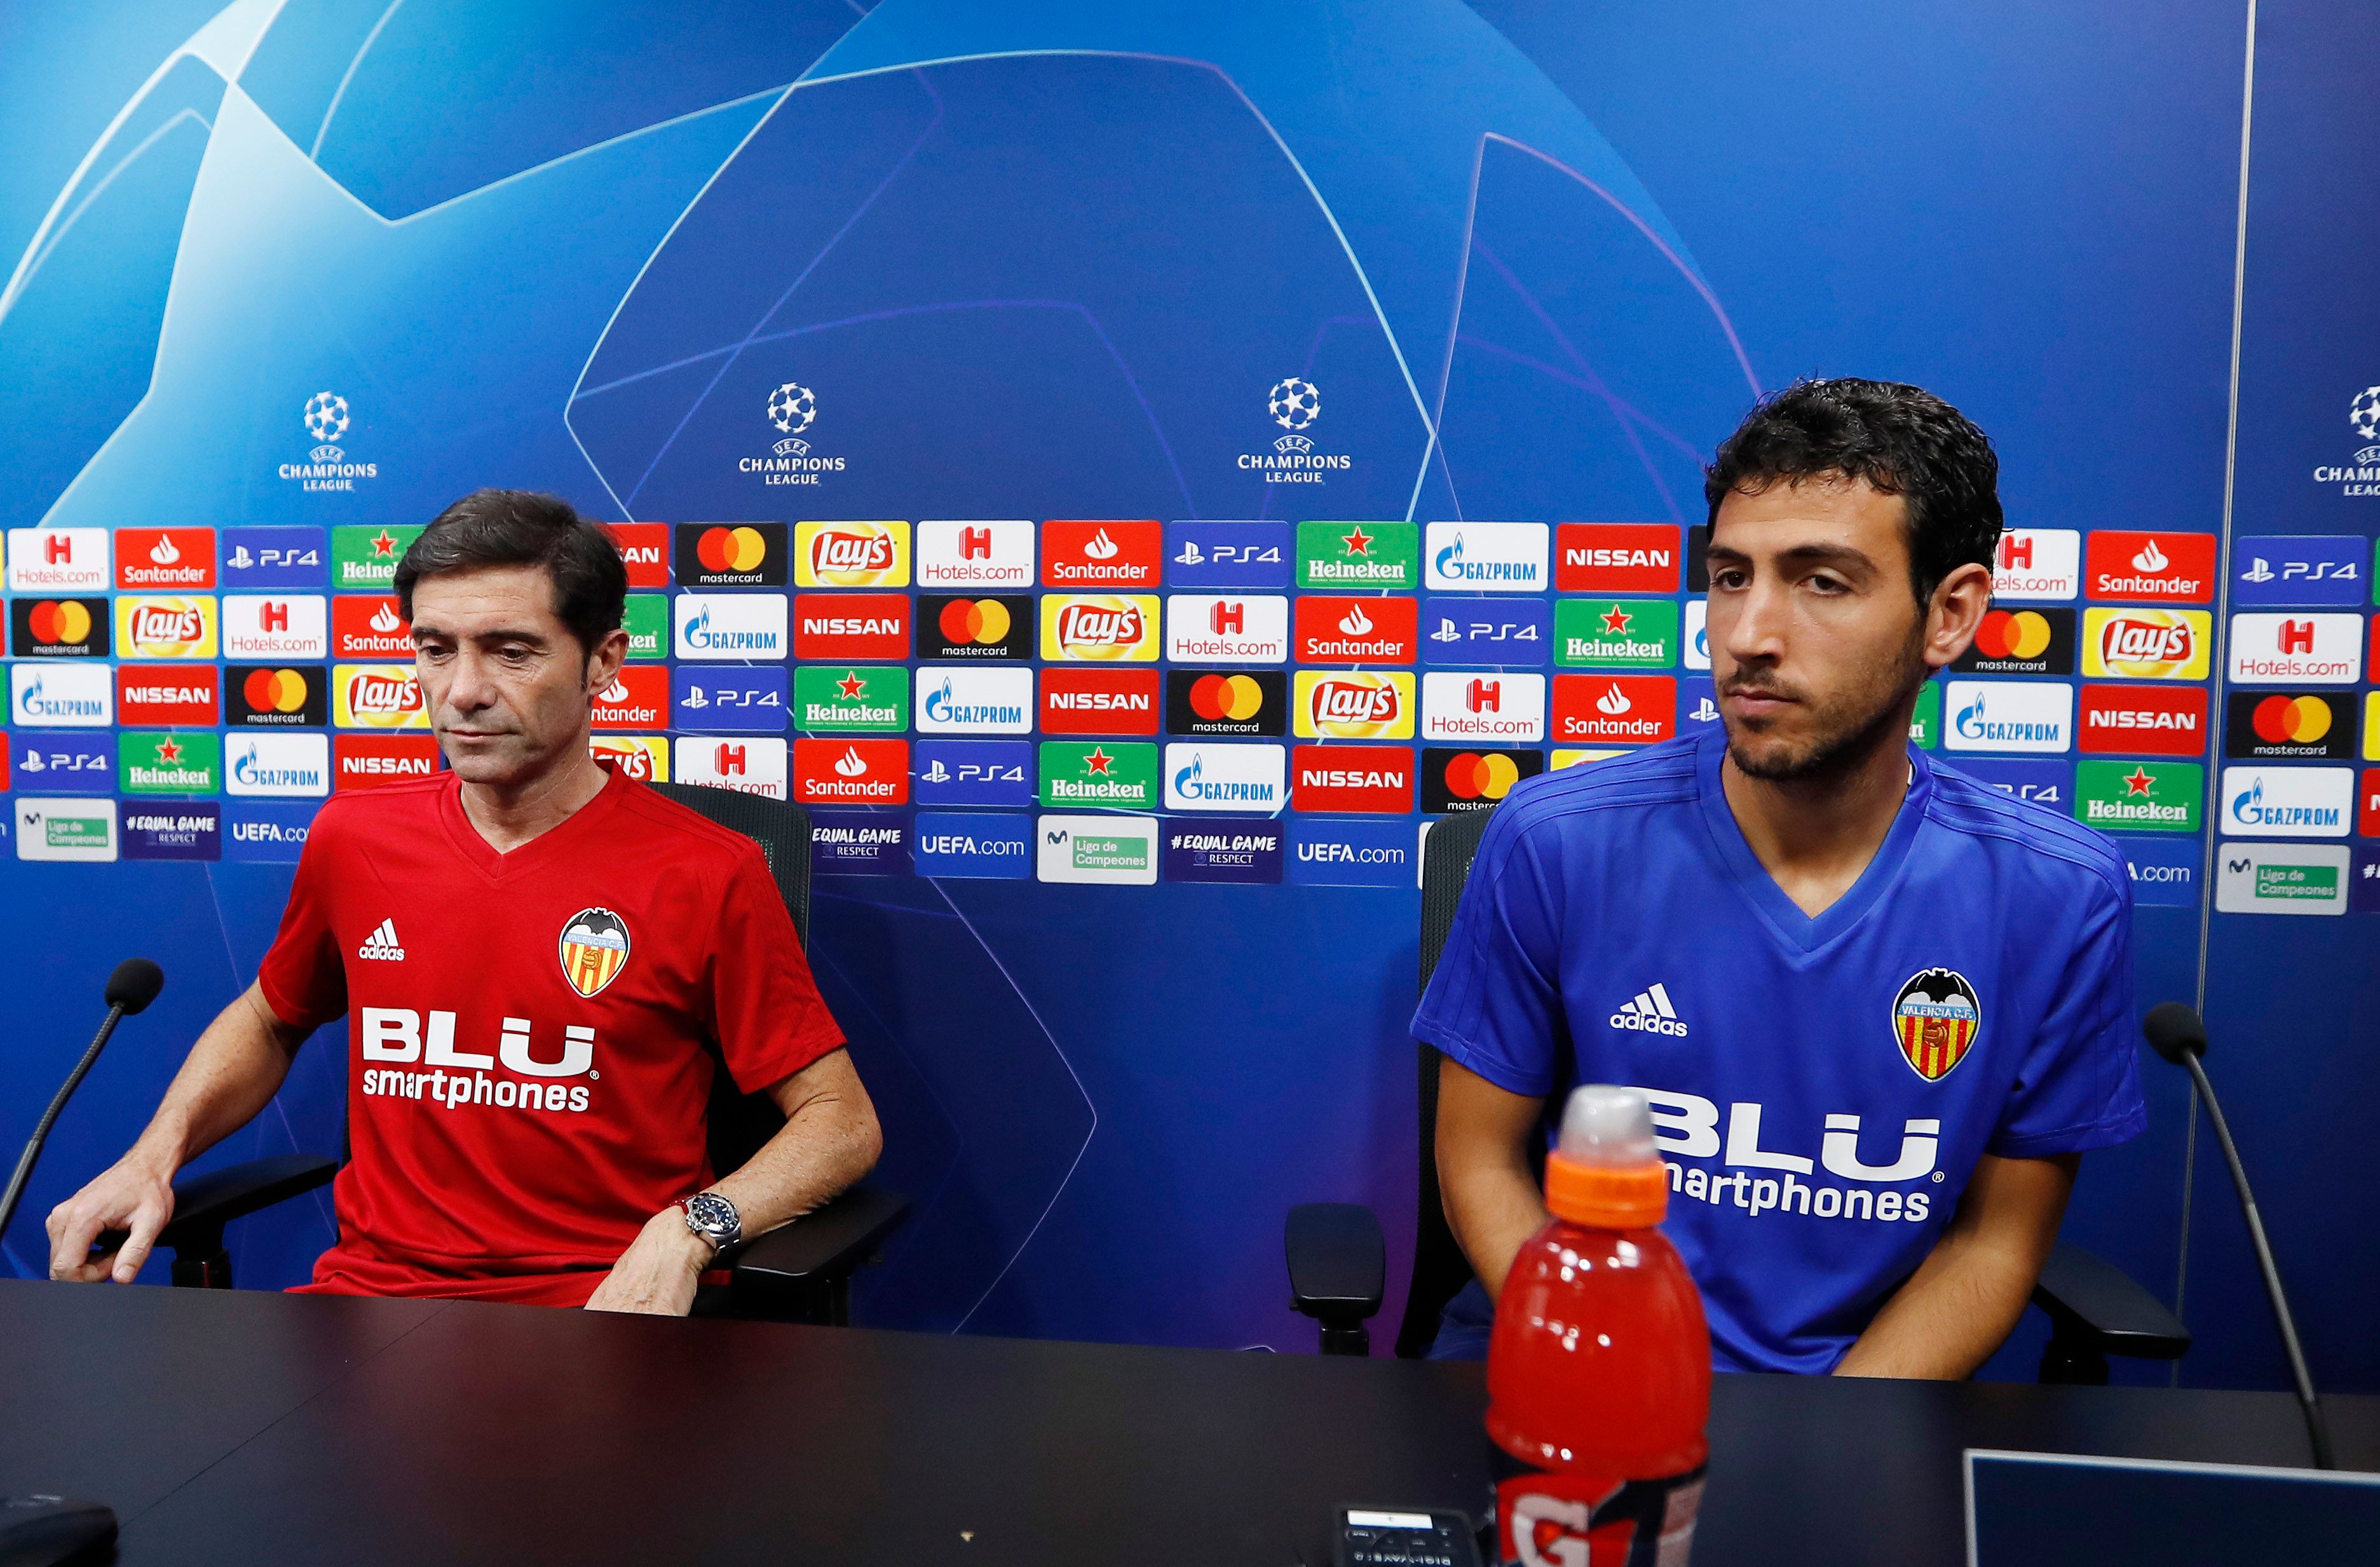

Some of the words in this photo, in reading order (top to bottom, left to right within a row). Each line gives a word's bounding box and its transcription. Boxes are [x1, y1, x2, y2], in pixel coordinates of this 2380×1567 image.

[774, 441, 808, 455] UEFA
[1275, 438, 1311, 452] UEFA
[310, 447, 343, 462] UEFA
[1237, 454, 1352, 470] CHAMPIONS
[2355, 449, 2380, 463] UE
[278, 463, 377, 479] CHAMPIONS
[738, 457, 847, 472] CHAMPIONS
[303, 479, 353, 492] LEAGUE
[765, 474, 819, 485] LEAGUE
[1266, 472, 1323, 483] LEAGUE
[44, 534, 71, 564] H
[959, 526, 991, 560] H
[260, 549, 319, 567] PS4
[817, 534, 886, 572] Lay's
[1213, 546, 1281, 563] PS4
[1567, 549, 1669, 567] NISSAN
[17, 568, 100, 583] Hotels.com
[125, 566, 206, 583] Santander
[343, 561, 398, 579] Heine
[700, 573, 763, 583] mastercard
[927, 564, 1024, 580] Hotels.com
[1054, 562, 1148, 579] Santander
[1309, 560, 1406, 579] Heineken
[1466, 562, 1536, 581] GAZPROM
[2283, 562, 2358, 580] PS4
[2098, 574, 2200, 594] Santander
[136, 604, 198, 638] Lay's
[260, 602, 288, 632] H
[1210, 601, 1243, 635] H
[804, 618, 899, 635] NISSAN
[1064, 606, 1137, 646] Lay's
[1470, 623, 1539, 641] PS4
[231, 636, 317, 652] Hotels.com
[343, 634, 416, 651] Santand
[712, 632, 777, 649] GAZPROM
[2107, 620, 2186, 661] Lay's
[2278, 620, 2314, 655] H
[33, 644, 90, 655] mastercard
[942, 645, 1007, 656] mastercard
[1177, 639, 1277, 655] Hotels.com
[1307, 637, 1404, 656] Santander
[1567, 638, 1664, 657] Heineken
[1976, 660, 2046, 672] mastercard
[2240, 659, 2348, 675] Hotels.com
[125, 686, 210, 703] NISSAN
[353, 676, 418, 712] Lay's
[716, 690, 780, 707] PS4
[1050, 693, 1149, 710] NISSAN
[1466, 678, 1500, 713] H
[45, 700, 102, 716] GAZPROM
[806, 703, 897, 721] Heineken
[1317, 685, 1392, 723] Lay's
[247, 713, 304, 724] mastercard
[590, 705, 656, 722] ntander
[954, 707, 1021, 723] GAZPROM
[2090, 710, 2196, 730] NISSAN
[1193, 722, 1259, 733] mastercard
[1432, 717, 1533, 734] Hotels.com
[1565, 717, 1662, 735] Santander
[1987, 722, 2059, 741] GAZPROM
[2255, 745, 2327, 756] mastercard
[51, 754, 107, 770] PS4
[343, 757, 430, 773] NISSAN
[715, 743, 745, 776] H
[129, 768, 209, 785] Heineken
[260, 770, 318, 786] GAZPROM
[959, 765, 1024, 782] PS4
[1302, 770, 1403, 789] NISSAN
[805, 780, 895, 796] Santander
[1052, 780, 1145, 797] Heineken
[1205, 782, 1273, 801] GAZPROM
[2088, 799, 2187, 820] Heineken
[2264, 808, 2339, 825] GAZPROM
[48, 820, 69, 834] Liga
[70, 822, 83, 832] de
[126, 816, 177, 832] #EQUAL
[177, 817, 215, 832] GAME
[233, 823, 309, 842] UEFA.co
[48, 832, 107, 846] Campeones
[158, 833, 196, 843] RESPECT
[858, 828, 901, 844] GAME
[1171, 834, 1230, 851] #EQUAL
[1232, 835, 1277, 851] GAME
[837, 846, 879, 856] RESPECT
[921, 836, 1024, 855] UEFA.com
[1077, 841, 1099, 855] Liga
[1102, 841, 1117, 852] de
[1298, 843, 1405, 864] UEFA.com
[1077, 855, 1145, 868] Campeones
[1209, 854, 1254, 864] RESPECT
[2261, 869, 2285, 883] Liga
[2290, 870, 2305, 881] de
[2259, 883, 2335, 897] Campeones
[568, 934, 607, 947] VALENCIA
[358, 944, 405, 961] adidas
[1901, 1005, 1952, 1017] VALENCIA
[1610, 1012, 1688, 1038] adidas
[362, 1007, 595, 1078] BLU
[362, 1068, 590, 1112] smartphones
